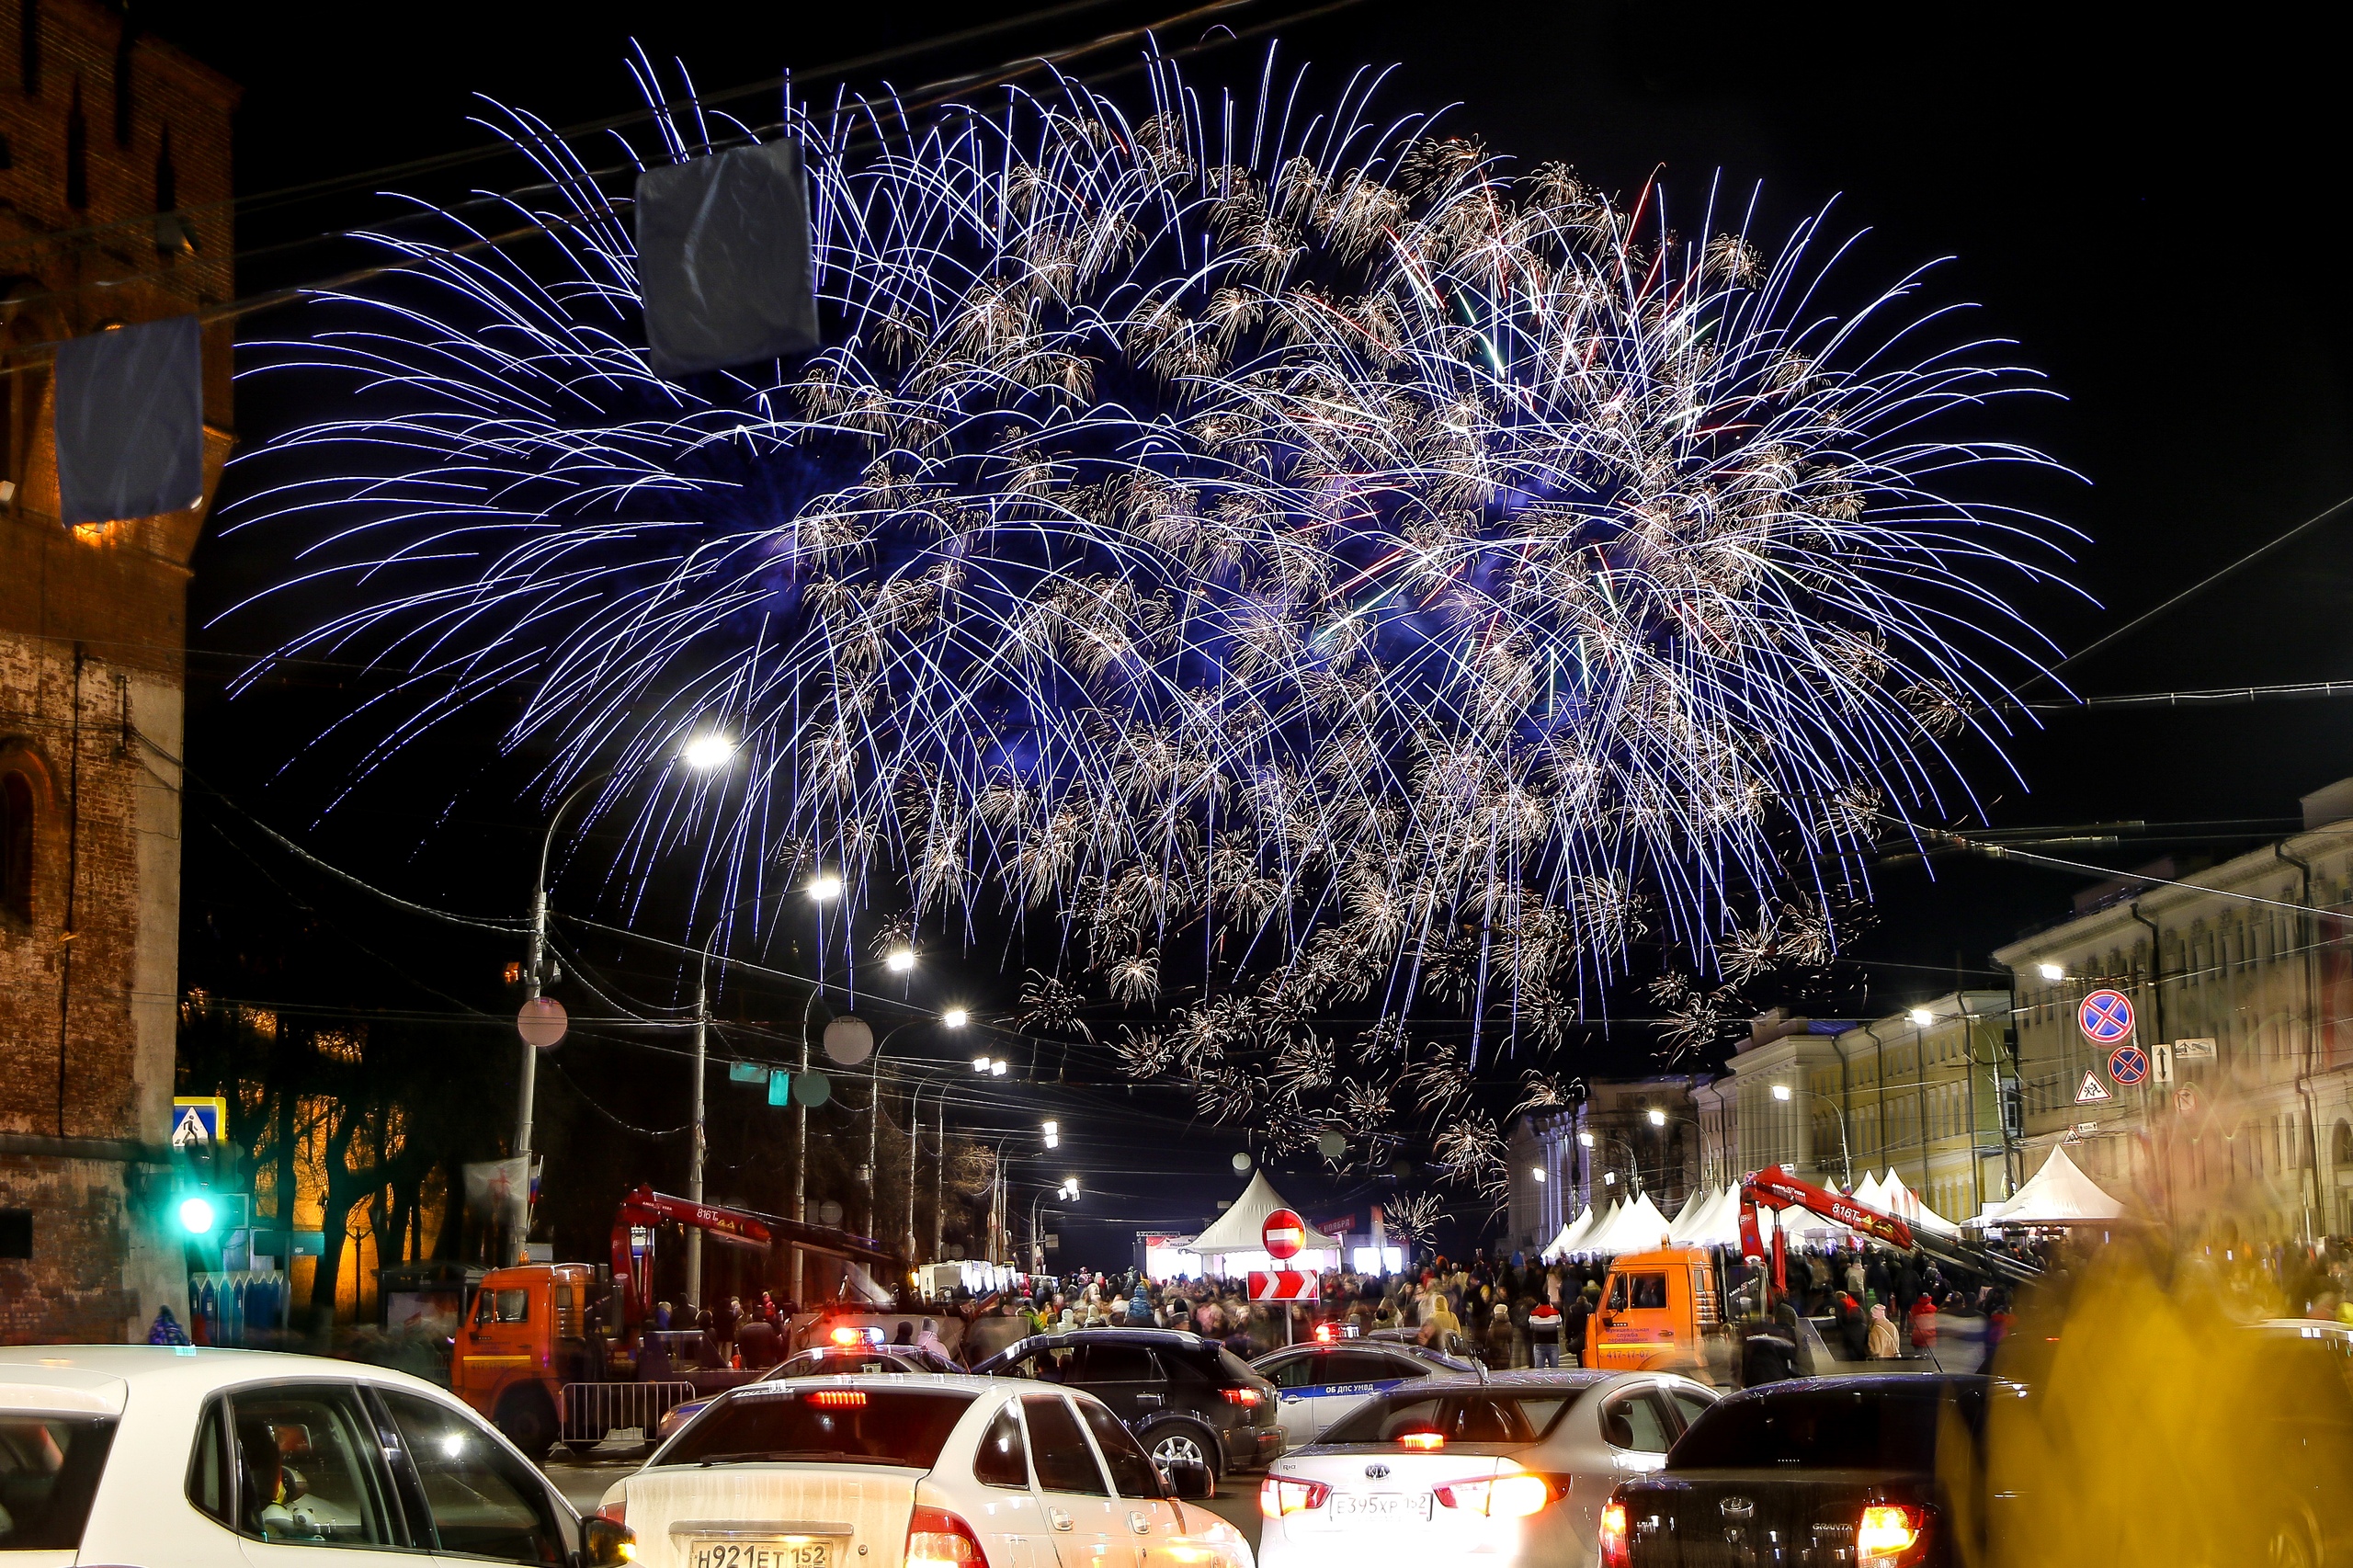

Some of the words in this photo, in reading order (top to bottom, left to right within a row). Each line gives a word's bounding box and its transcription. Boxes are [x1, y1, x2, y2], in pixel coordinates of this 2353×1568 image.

[1324, 1218, 1350, 1233] НОЯБРЯ
[1607, 1350, 1650, 1358] 417-17-07
[1325, 1386, 1336, 1394] ОБ
[1337, 1385, 1353, 1394] ДПС
[1353, 1383, 1374, 1392] УМВД
[1367, 1465, 1389, 1477] KIA
[1812, 1522, 1853, 1530] GRANTA
[790, 1545, 825, 1564] 152
